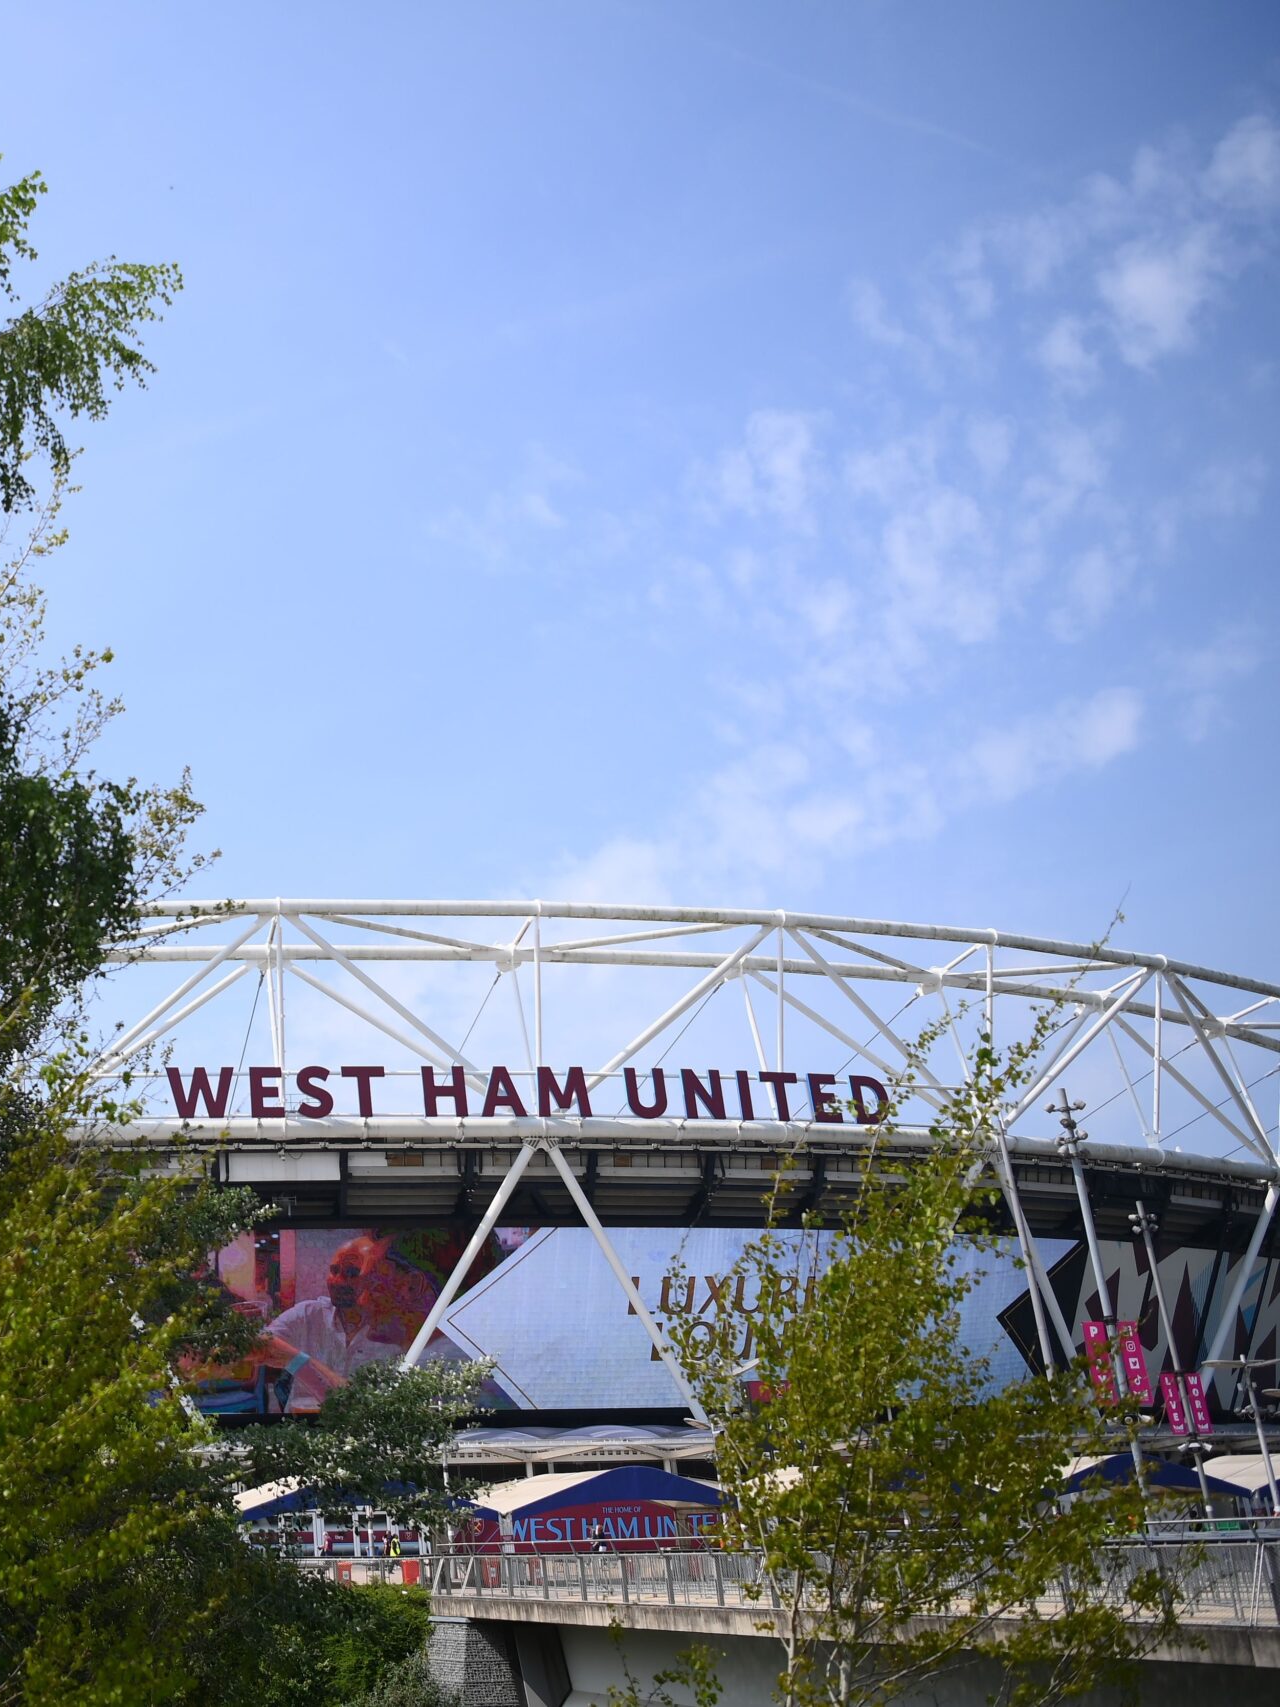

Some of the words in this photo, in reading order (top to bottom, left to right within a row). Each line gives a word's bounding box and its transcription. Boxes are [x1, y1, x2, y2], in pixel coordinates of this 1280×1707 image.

[166, 1066, 384, 1118] WEST
[421, 1066, 591, 1118] HAM
[625, 1067, 889, 1124] UNITED
[1089, 1326, 1108, 1384] PY
[1164, 1376, 1180, 1421] LIVE
[1188, 1376, 1206, 1421] WORK
[512, 1517, 576, 1542] WEST
[581, 1516, 638, 1541] HAM
[602, 1506, 614, 1514] THE
